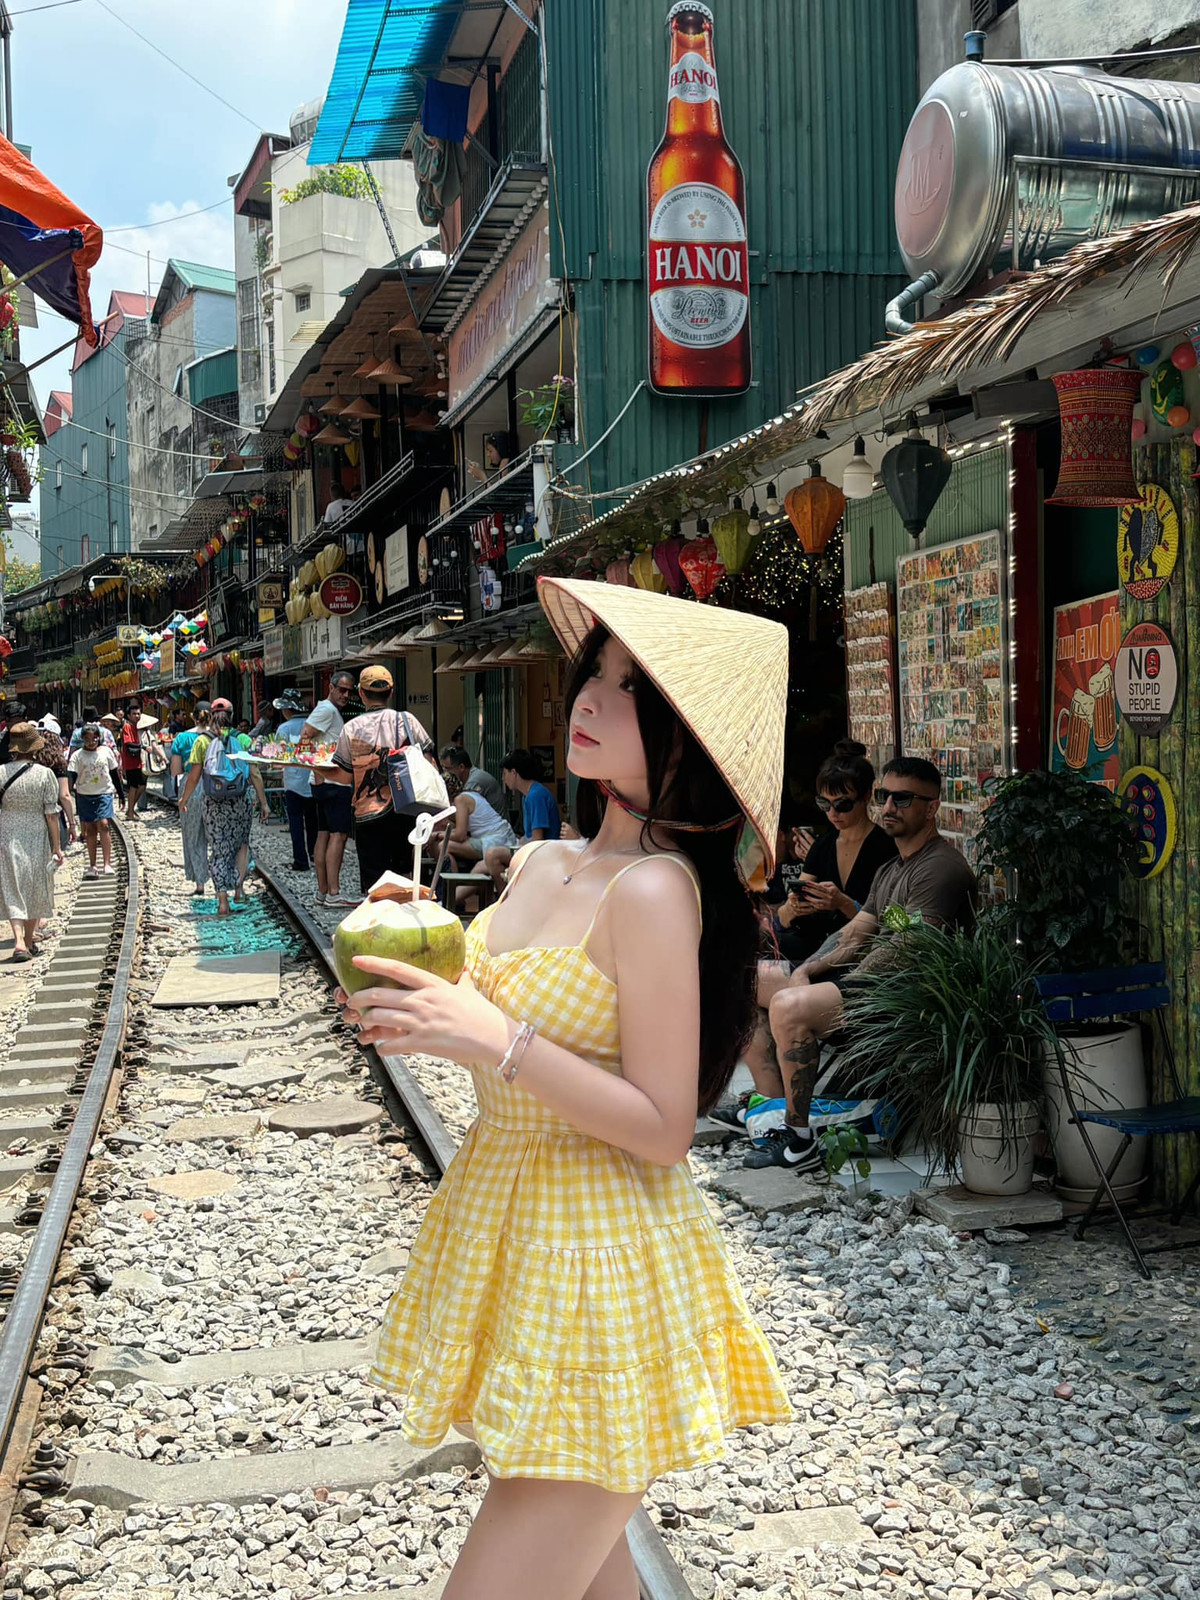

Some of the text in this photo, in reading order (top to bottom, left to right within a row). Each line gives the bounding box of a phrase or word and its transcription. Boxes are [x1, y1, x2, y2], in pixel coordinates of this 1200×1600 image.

[670, 68, 717, 90] HANOI
[655, 246, 742, 282] HANOI
[1076, 624, 1098, 663] EM
[1129, 648, 1161, 680] NO
[1128, 682, 1160, 696] STUPID
[1128, 698, 1161, 711] PEOPLE
